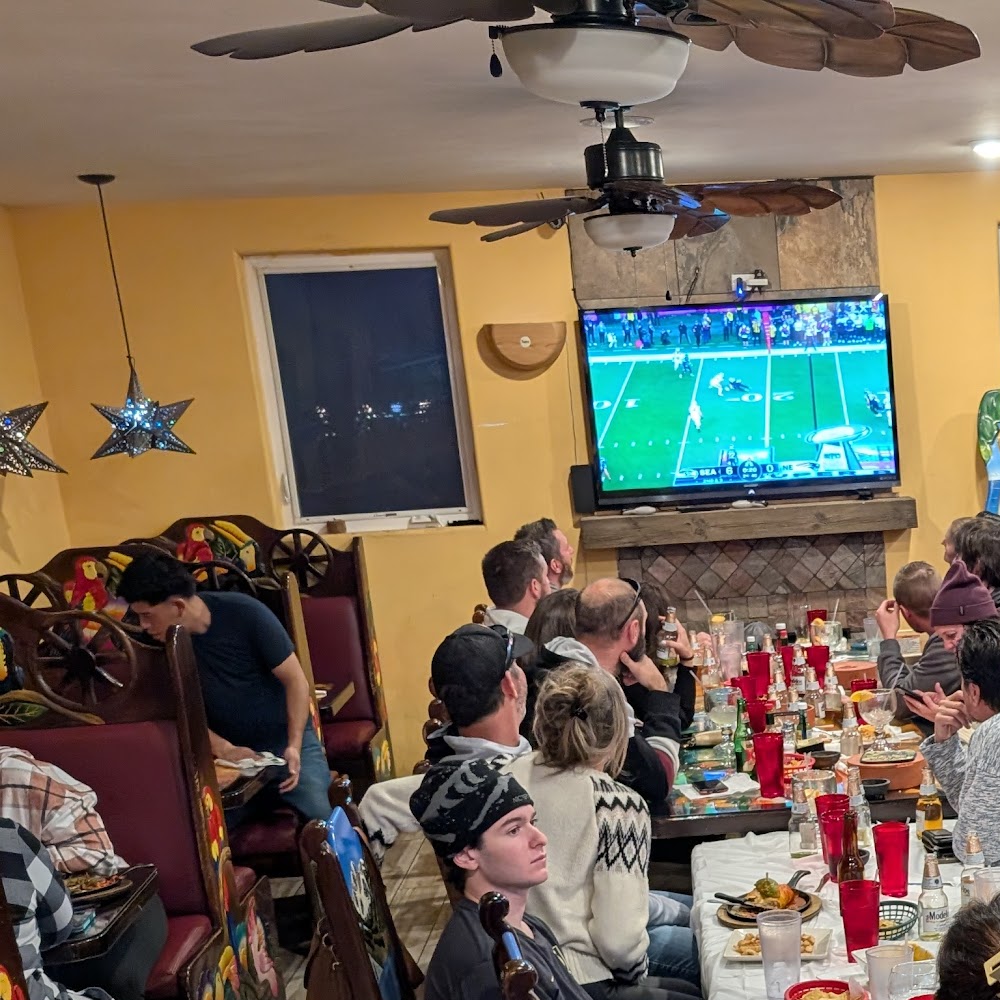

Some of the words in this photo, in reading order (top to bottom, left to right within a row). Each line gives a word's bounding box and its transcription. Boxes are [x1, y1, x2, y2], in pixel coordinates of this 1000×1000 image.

[699, 468, 717, 476] SEA
[725, 466, 734, 475] 6
[765, 464, 774, 473] 0
